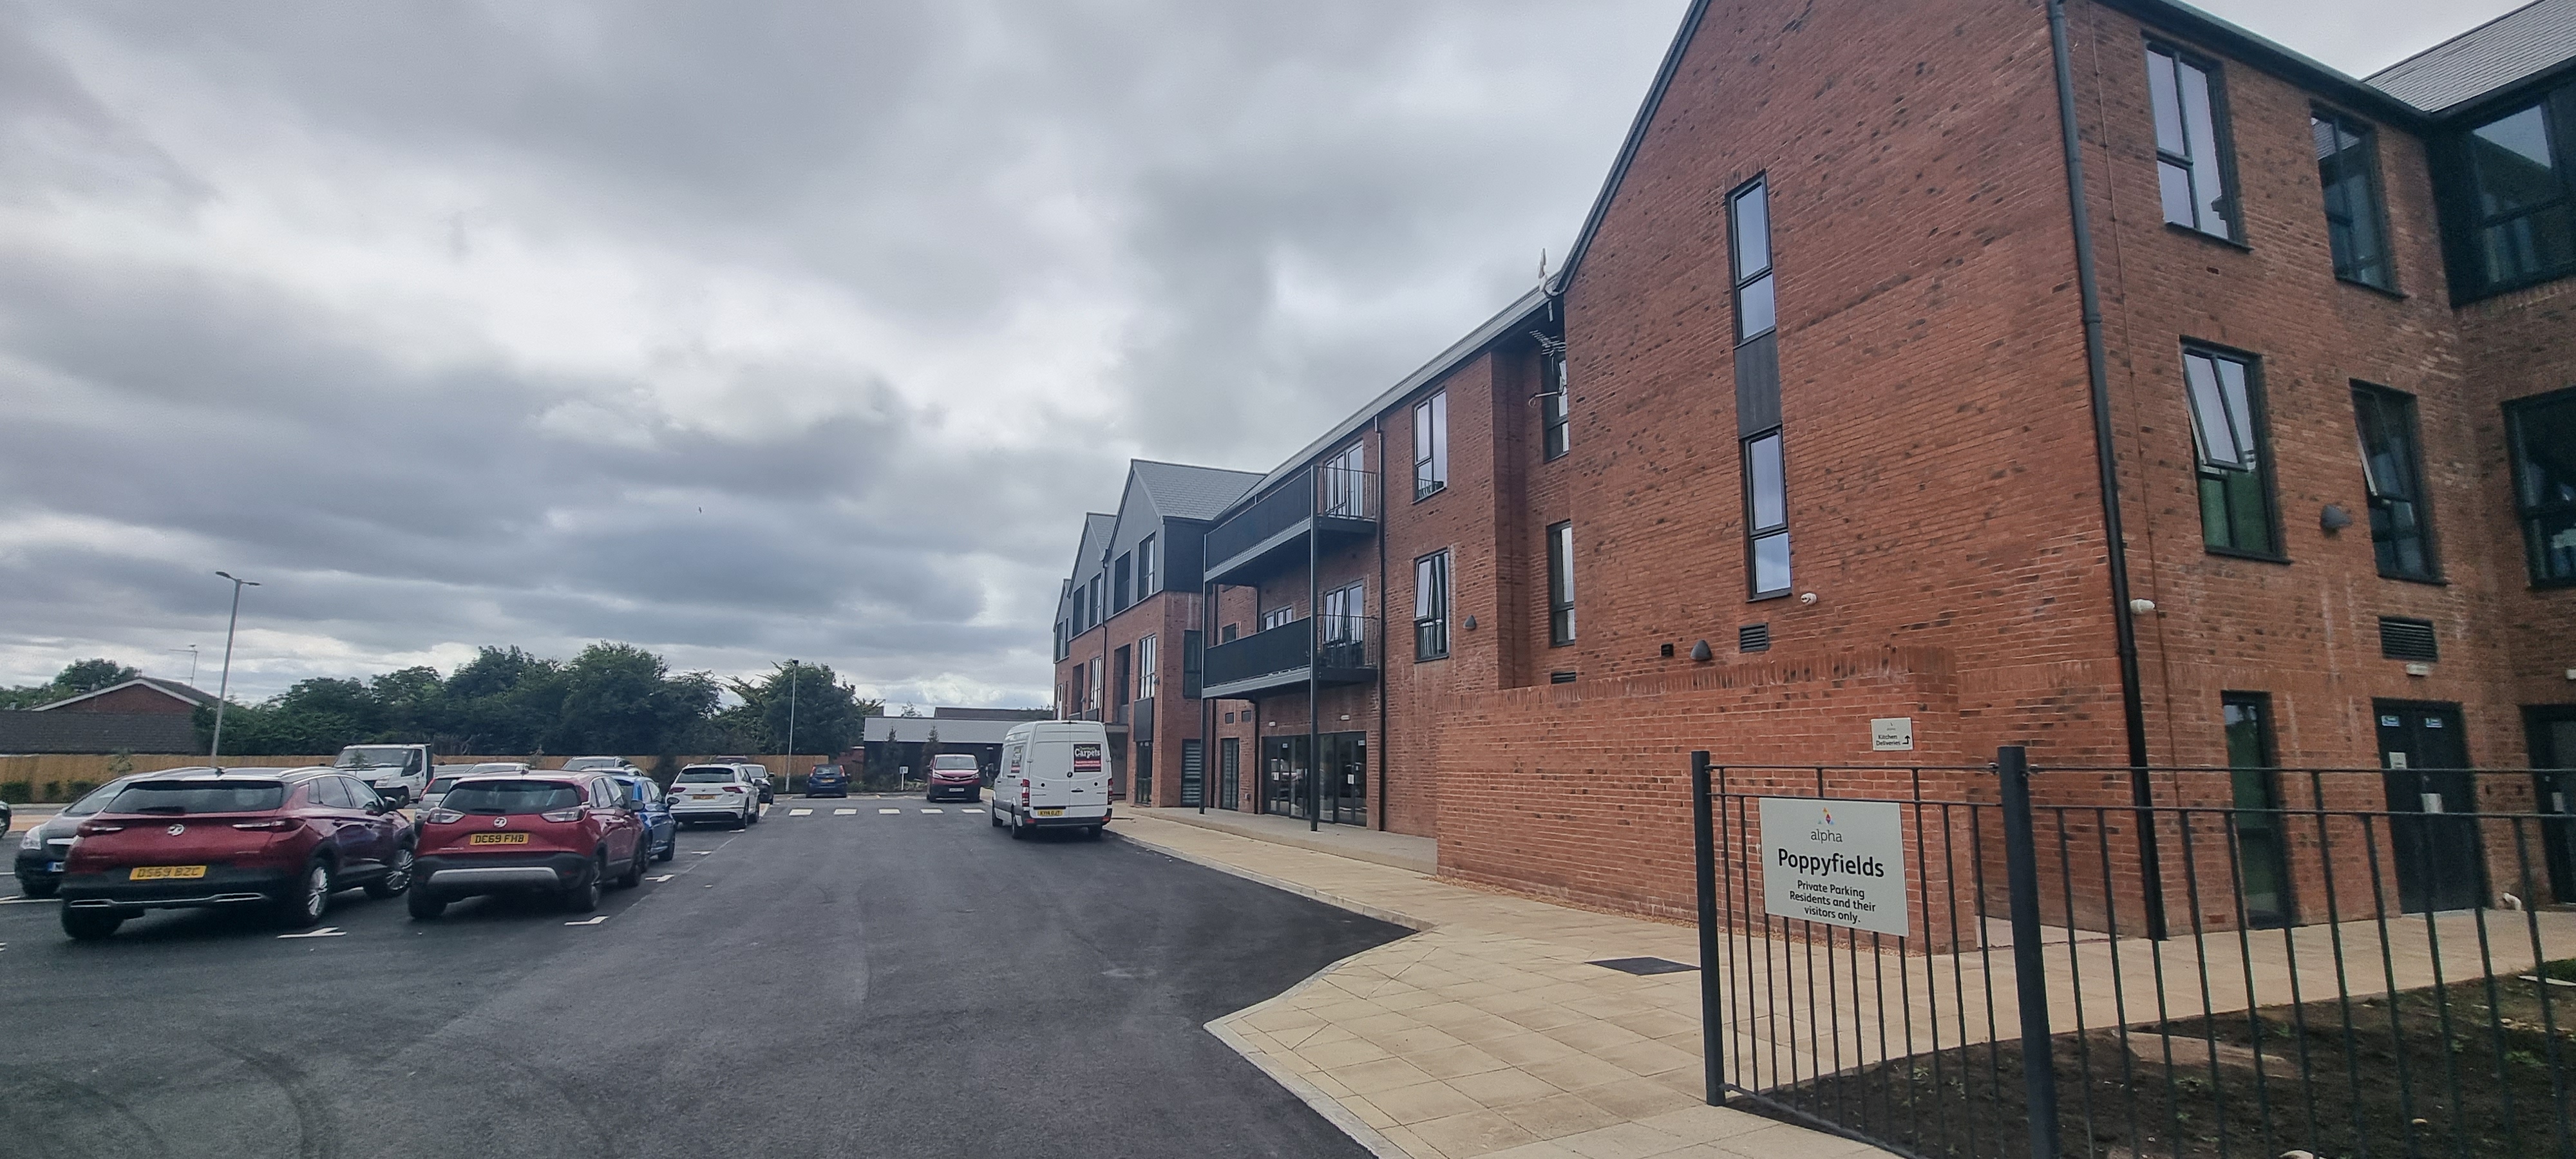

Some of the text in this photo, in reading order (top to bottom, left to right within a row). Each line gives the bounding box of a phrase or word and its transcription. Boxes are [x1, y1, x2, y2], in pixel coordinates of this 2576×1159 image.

[1075, 748, 1101, 759] Carpets
[475, 834, 524, 843] DC69 FHB
[1810, 829, 1843, 843] alpha
[1778, 848, 1884, 878] Poppyfields
[1797, 880, 1865, 900] Private Parking
[1790, 890, 1875, 912] Residents and their
[1804, 905, 1861, 925] visitors only.
